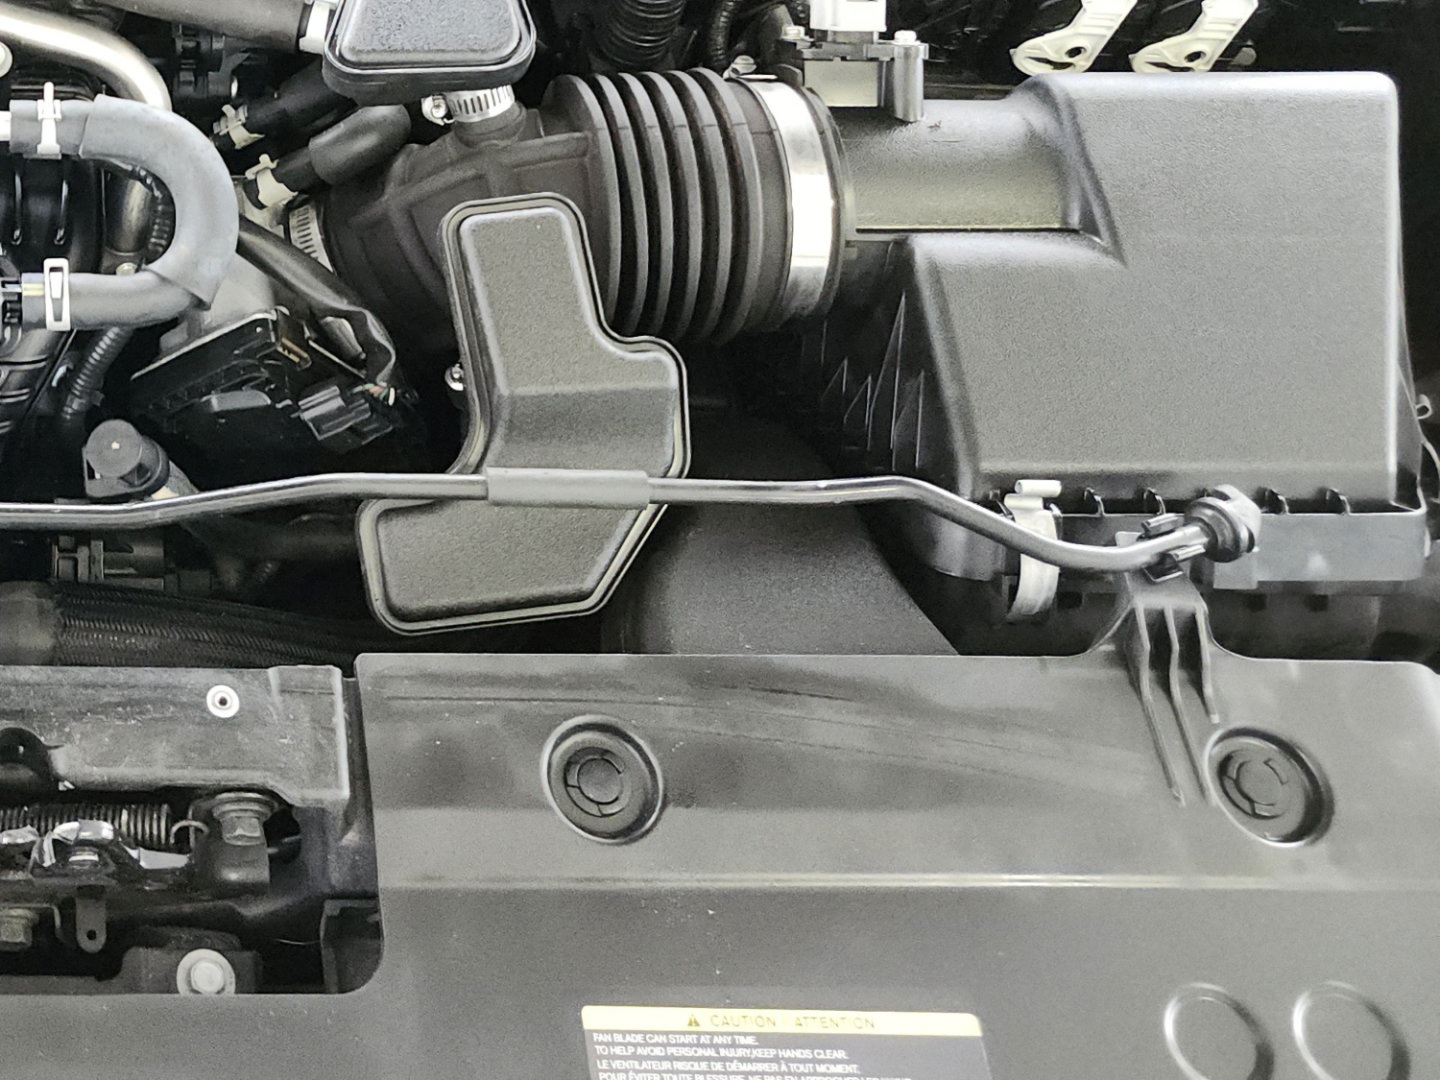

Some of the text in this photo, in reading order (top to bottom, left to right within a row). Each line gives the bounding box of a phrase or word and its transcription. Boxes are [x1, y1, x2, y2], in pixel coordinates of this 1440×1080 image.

[710, 1014, 776, 1028] CAUTION
[593, 1032, 612, 1042] FAN
[613, 1033, 645, 1043] BLADE
[646, 1033, 667, 1043] CAN
[668, 1034, 698, 1044] START
[699, 1035, 712, 1044] AT
[712, 1035, 733, 1044] ANY
[595, 1045, 608, 1055] TO
[610, 1045, 635, 1055] HELP
[636, 1046, 666, 1056] AVOID
[666, 1046, 719, 1057] PERSONAL
[779, 1049, 812, 1059] HANDS
[597, 1059, 610, 1069] LE
[610, 1060, 672, 1070] VENTILATEUR
[673, 1061, 709, 1071] RISQUE
[711, 1061, 725, 1071] DE
[726, 1059, 779, 1072] DÉMARRER
[780, 1060, 787, 1071] À
[788, 1062, 814, 1072] TOUT
